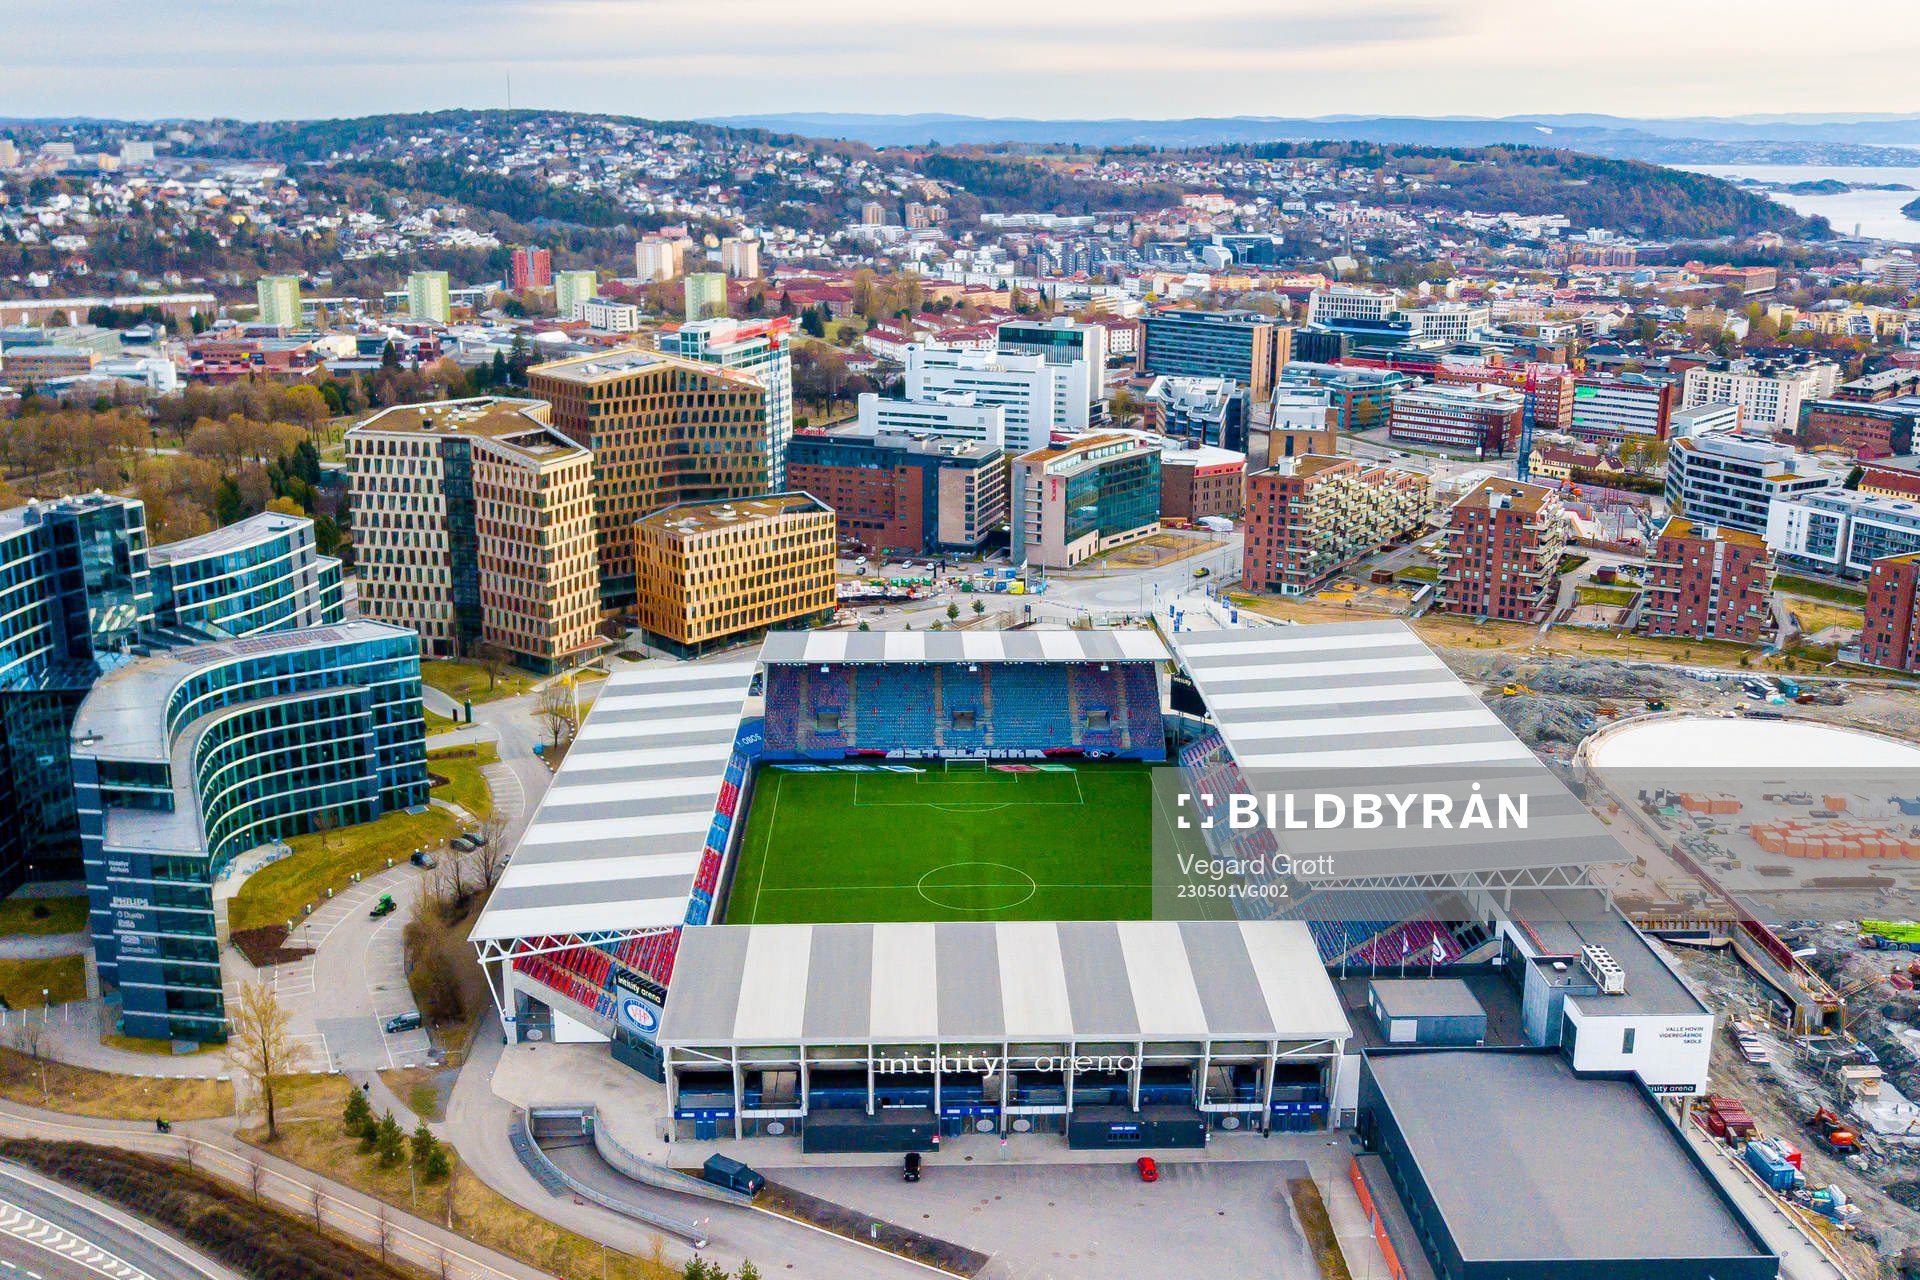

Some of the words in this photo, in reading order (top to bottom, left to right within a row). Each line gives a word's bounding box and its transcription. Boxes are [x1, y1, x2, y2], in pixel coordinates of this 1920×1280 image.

[741, 733, 762, 745] OBOS
[879, 1051, 999, 1079] intility
[1034, 1055, 1138, 1073] arena
